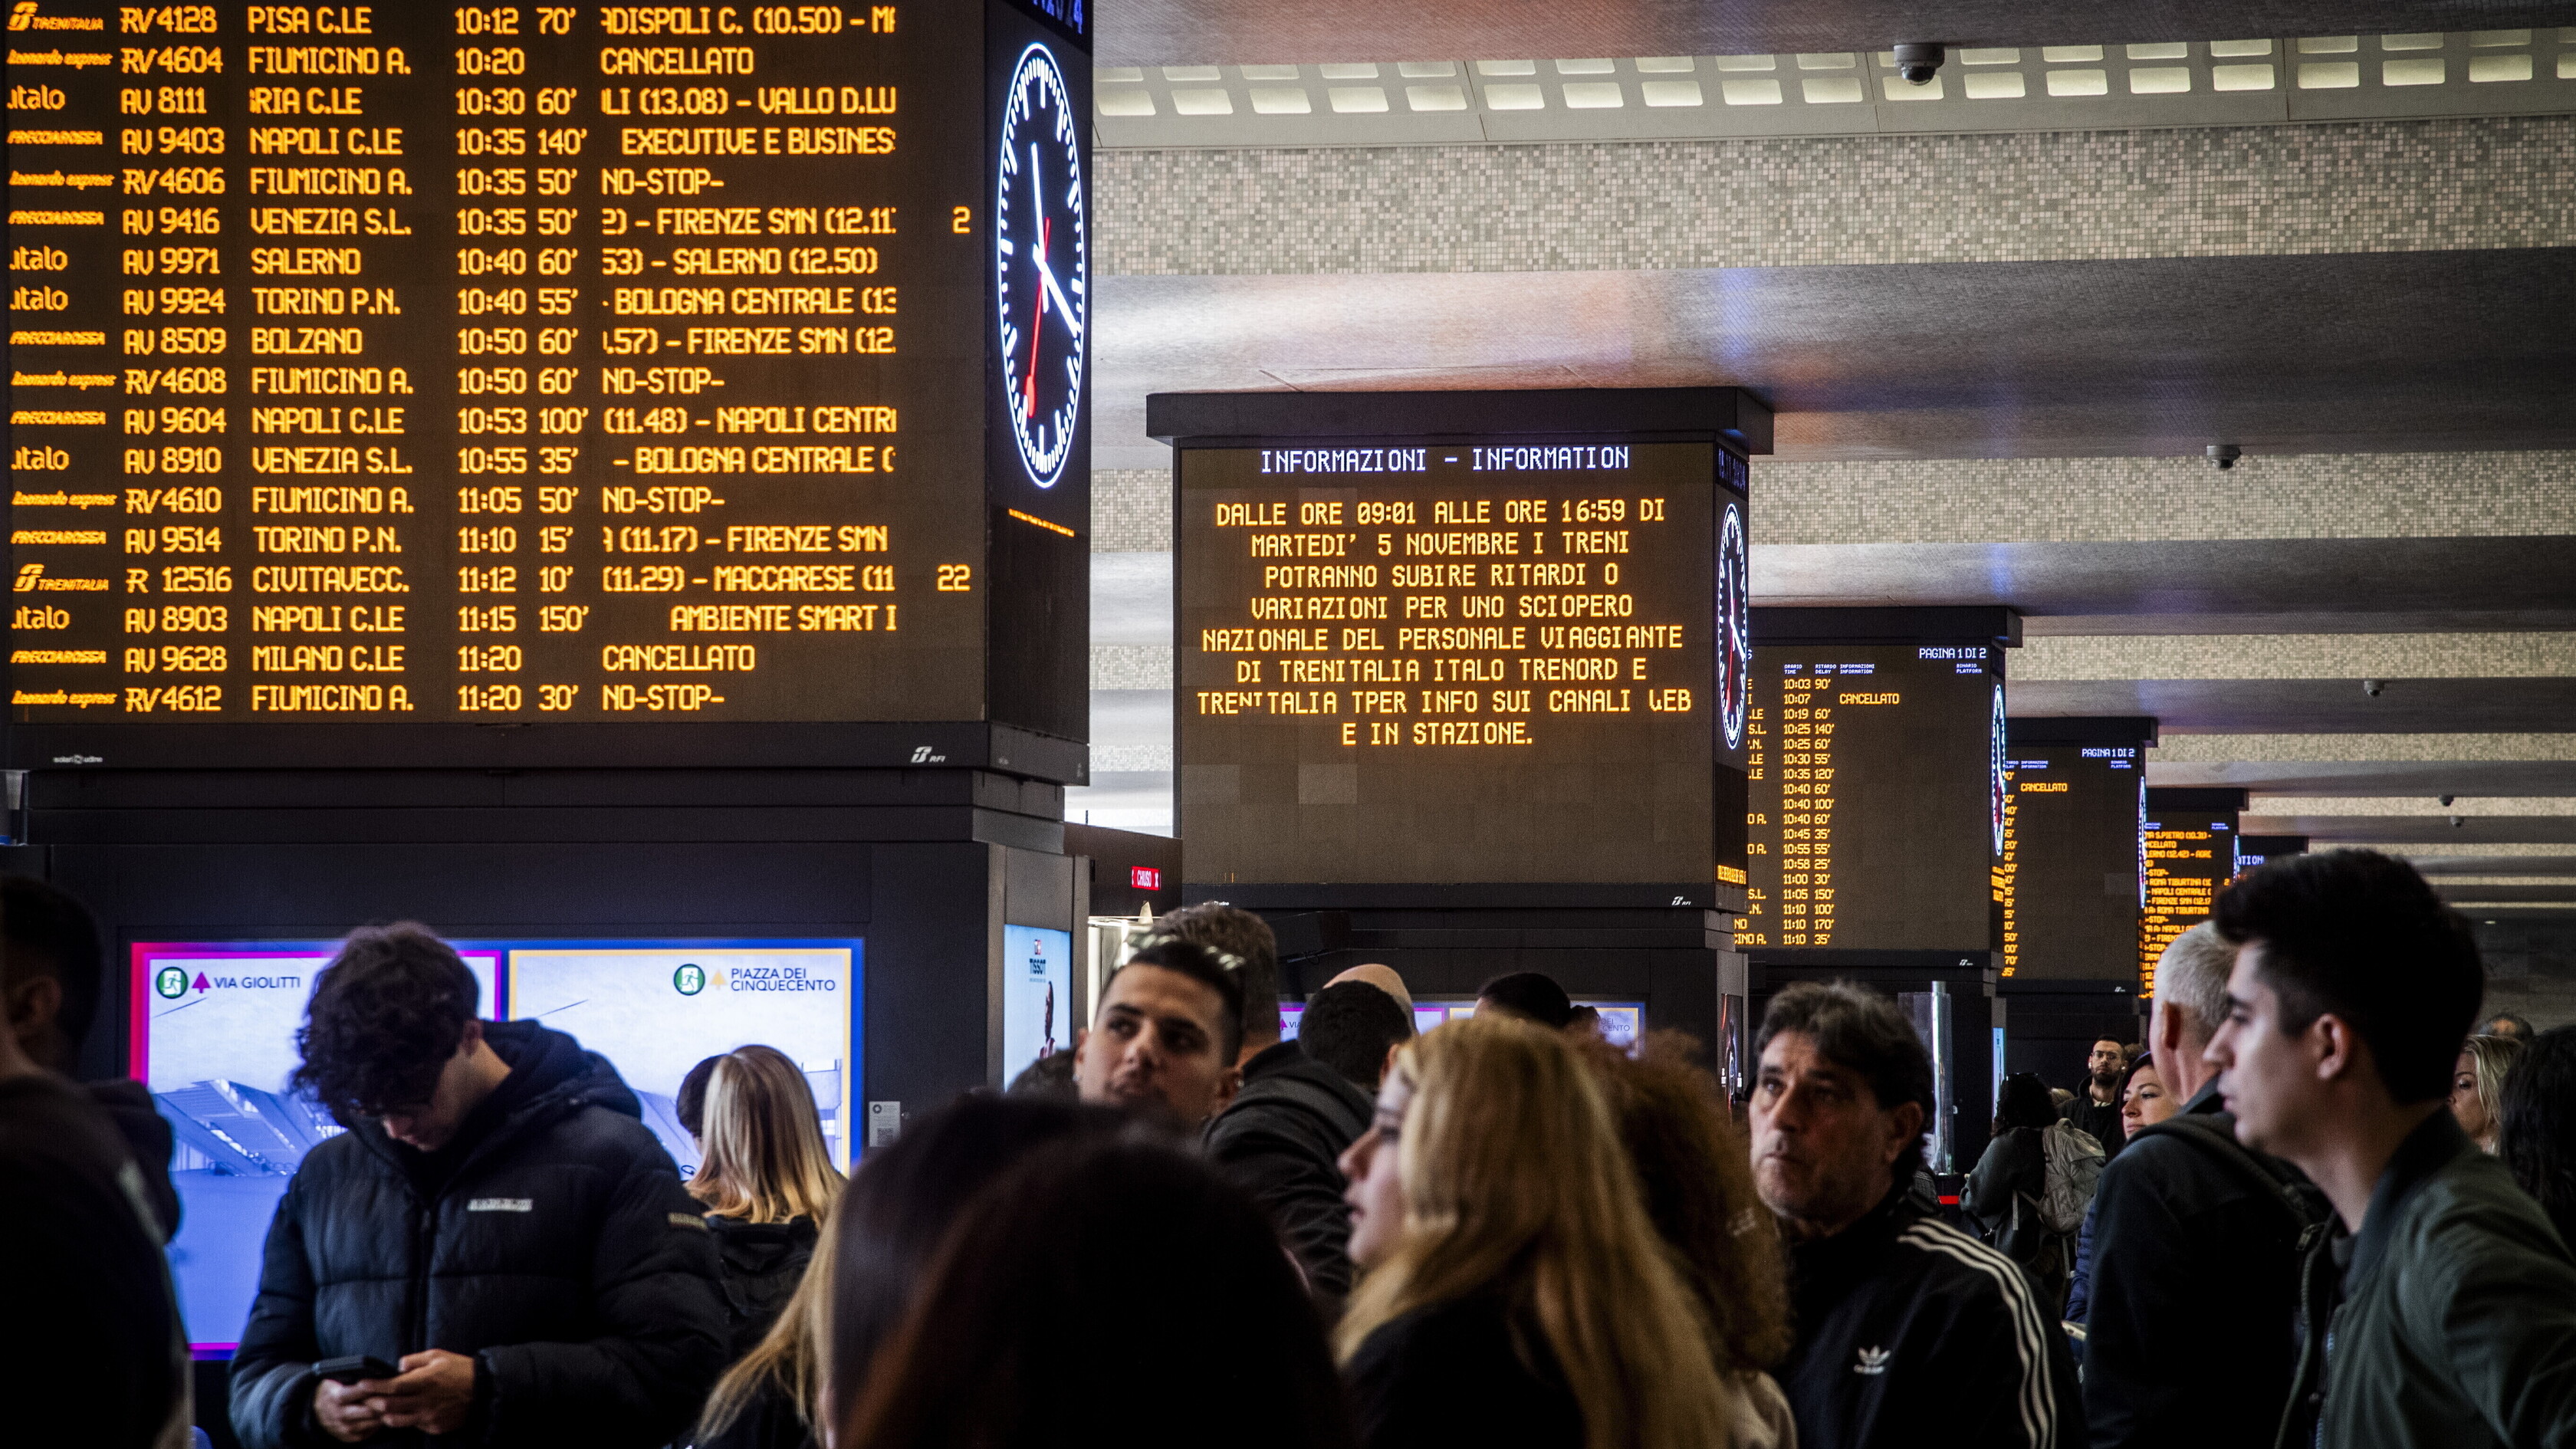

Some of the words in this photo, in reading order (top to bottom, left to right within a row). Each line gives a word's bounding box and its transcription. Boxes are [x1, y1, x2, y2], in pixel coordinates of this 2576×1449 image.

[32, 17, 104, 30] TRENITALIA
[248, 6, 310, 35] PISA
[316, 6, 373, 35] C.LE
[455, 6, 519, 35] 10:12
[248, 46, 380, 75] FIUMICINO
[386, 46, 412, 75] A.
[455, 46, 525, 75] 10:20
[600, 45, 754, 75] CANCELLATO
[157, 86, 207, 114] 8111
[306, 87, 363, 116] C.LE
[455, 87, 526, 116] 10:30
[757, 86, 835, 116] VALLO
[249, 127, 340, 156] NAPOLI
[347, 127, 403, 156] C.LE
[455, 127, 527, 156] 10:35
[621, 126, 757, 156] EXECUTIVE
[250, 167, 381, 196] FIUMICINO
[387, 167, 413, 196] A.
[456, 167, 527, 196] 10:35
[601, 166, 724, 196] NO-STOP-
[250, 207, 358, 236] VENEZIA
[363, 207, 412, 236] S.L.
[456, 207, 527, 236] 10:35
[656, 206, 762, 236] FIRENZE
[767, 206, 818, 236] SMN
[251, 247, 362, 276] SALERNO
[456, 247, 527, 276] 10:40
[672, 246, 783, 276] SALERNO
[788, 246, 879, 276] (12.50)
[251, 287, 345, 315] TORINO
[350, 287, 402, 315] P.N.
[457, 287, 527, 315] 10:40
[614, 286, 725, 315] BOLOGNA
[731, 286, 855, 315] CENTRALE
[251, 327, 363, 356] BOLZANO
[457, 327, 527, 356] 10:50
[251, 366, 383, 395] FIUMICINO
[388, 366, 414, 395] A.
[457, 366, 528, 395] 10:50
[251, 406, 342, 435] NAPOLI
[349, 406, 406, 435] C.LE
[457, 406, 528, 435] 10:53
[603, 406, 688, 435] (11.48)
[716, 406, 807, 435] NAPOLI
[251, 446, 360, 475] VENEZIA
[365, 446, 413, 475] S.L.
[457, 446, 528, 475] 10:55
[1261, 448, 1426, 474] INFORMAZIONI
[1473, 445, 1628, 472] INFORMATION
[252, 485, 383, 514] FIUMICINO
[389, 485, 415, 514] A.
[457, 485, 523, 514] 11:05
[1216, 502, 1286, 527] DALLE
[1300, 501, 1343, 527] ORE
[1357, 501, 1417, 526] 09:01
[1434, 499, 1491, 525] ALLE
[1504, 499, 1548, 524] ORE
[1561, 498, 1625, 524] 16:59
[1640, 498, 1665, 522] DI
[252, 525, 346, 554] TORINO
[351, 525, 402, 554] P.N.
[458, 525, 518, 554] 11:10
[1378, 533, 1392, 557] 5
[1405, 531, 1519, 557] NOVEMBRE
[1533, 531, 1544, 555] I
[1562, 530, 1629, 554] TRENI
[252, 565, 410, 593] CIVITAVECC.
[458, 565, 518, 593] 11:12
[713, 564, 856, 593] MACCARESE
[937, 564, 971, 593] 22
[1264, 564, 1378, 590] POTRANNO
[1391, 564, 1477, 588] SUBIRE
[1490, 562, 1586, 587] RITARDI
[1604, 561, 1619, 586] O
[252, 605, 343, 633] NAPOLI
[349, 605, 406, 633] C.LE
[458, 605, 517, 633] 11:15
[669, 604, 793, 633] AMBIENTE
[797, 604, 879, 633] SMART
[1250, 596, 1388, 620] VARIAZIONI
[1405, 595, 1448, 620] PER
[1461, 594, 1505, 619] UNO
[1518, 593, 1633, 619] SCIOPERO
[1201, 628, 1329, 653] NAZIONALE
[1342, 627, 1385, 652] DEL
[1398, 626, 1526, 651] PERSONALE
[1540, 624, 1683, 650] VIAGGIANTE
[252, 645, 343, 672] MILANO
[349, 645, 406, 672] C.LE
[457, 645, 522, 672] 11:20
[602, 644, 756, 672] CANCELLATO
[1919, 647, 1956, 659] PAGINA
[1957, 648, 1963, 659] 1
[1964, 647, 1976, 659] DI
[1978, 647, 1987, 659] 2
[1237, 659, 1262, 684] DI
[1280, 658, 1421, 683] TRENITALIA
[1433, 658, 1505, 682] ITALO
[1518, 656, 1618, 682] TRENORD
[1632, 656, 1647, 681] E
[251, 684, 383, 711] FIUMICINO
[389, 684, 414, 711] A.
[457, 684, 522, 711] 11:20
[1783, 678, 1812, 691] 10:03
[1351, 690, 1408, 715] TPER
[1421, 689, 1479, 715] INFO
[1492, 688, 1531, 714] SUI
[1548, 688, 1631, 713] CANALI
[1783, 692, 1812, 705] 10:07
[1839, 692, 1900, 705] CANCELLATO
[1783, 708, 1809, 721] 10:19
[1341, 721, 1356, 746] E
[1371, 721, 1401, 746] IN
[1413, 721, 1533, 746] STAZIONE.
[1783, 722, 1812, 735] 10:25
[1783, 753, 1811, 766] 10:30
[2082, 748, 2111, 758] PAGINA
[2111, 748, 2117, 758] 1
[2117, 748, 2128, 758] DI
[2128, 748, 2136, 758] 2
[2020, 782, 2068, 793] CANCELLATO
[1783, 797, 1812, 810] 10:40
[1783, 843, 1811, 856] 10:55
[1783, 888, 1809, 901] 11:05
[2149, 878, 2167, 886] ROMA
[2150, 887, 2174, 896] NAPOLI
[2174, 887, 2206, 896] CENTRALE
[2151, 897, 2179, 905] FIRENZE
[1783, 933, 1807, 946] 11:10
[214, 976, 237, 989] VIA
[241, 975, 301, 989] GIOLITTI
[731, 968, 780, 979] PIAZZA
[784, 968, 807, 979] DEI
[731, 979, 836, 991] CINQUECENTO
